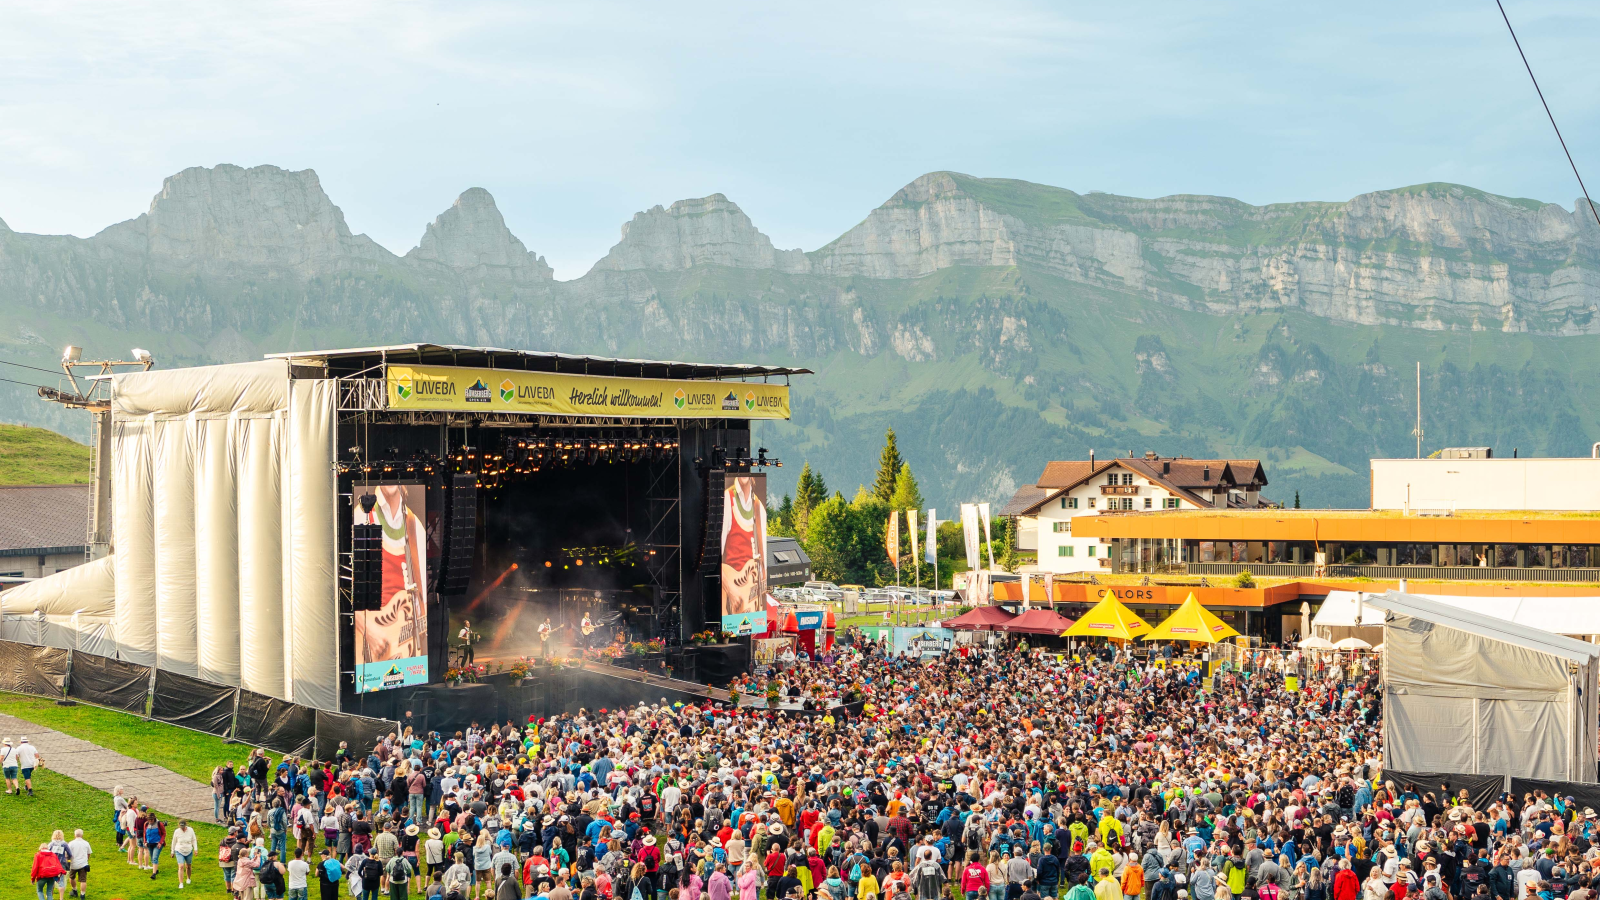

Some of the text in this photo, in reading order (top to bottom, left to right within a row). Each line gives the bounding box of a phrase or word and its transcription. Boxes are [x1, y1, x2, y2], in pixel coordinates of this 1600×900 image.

[415, 380, 456, 395] LAVEBA
[518, 385, 555, 399] LAVEBA
[569, 386, 662, 407] Herzlich willkommen!
[687, 393, 716, 405] LAVEBA
[756, 396, 782, 407] LAVEBA
